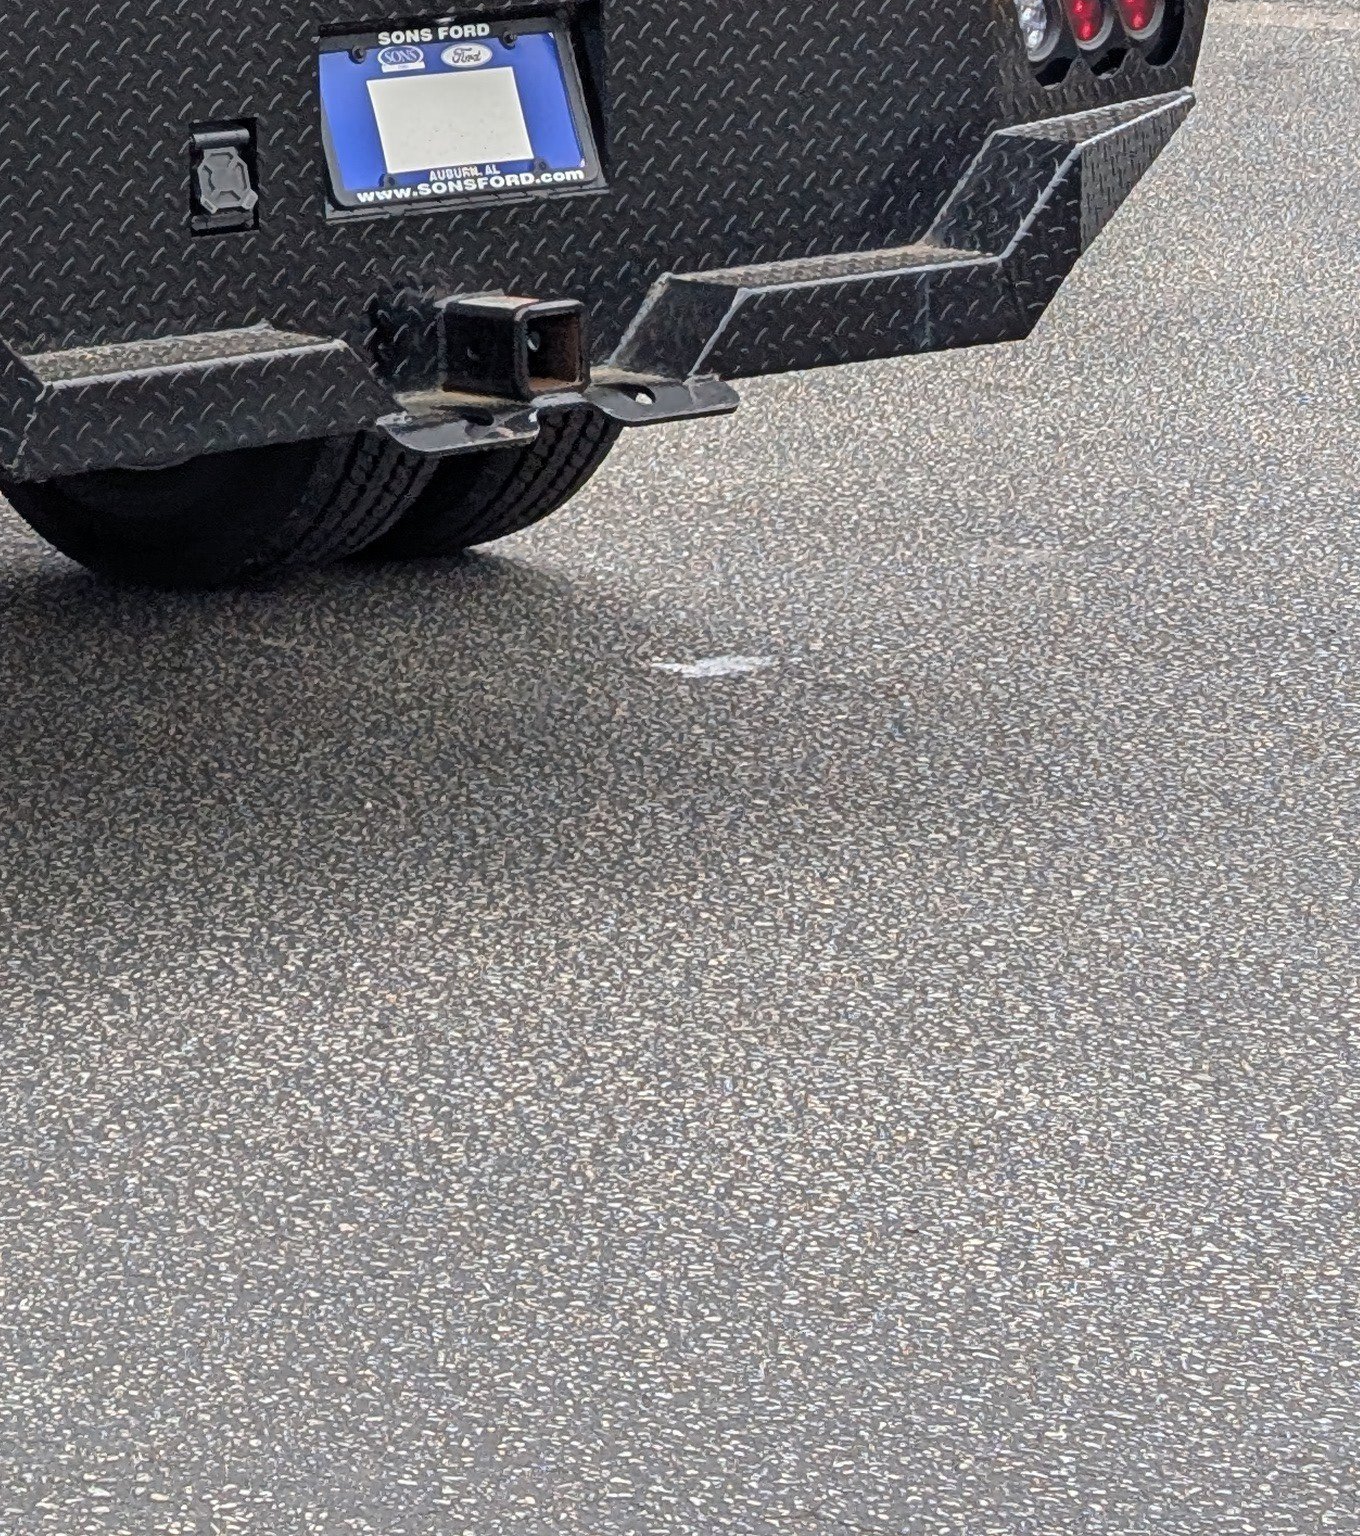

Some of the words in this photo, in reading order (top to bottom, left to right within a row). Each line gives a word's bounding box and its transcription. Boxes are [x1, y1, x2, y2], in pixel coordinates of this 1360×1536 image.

[378, 28, 433, 45] SONS
[438, 23, 490, 40] FORD
[383, 48, 418, 64] SONS
[451, 47, 481, 63] Ford
[485, 164, 501, 176] AL
[356, 169, 585, 203] www.SONSFORD.com
